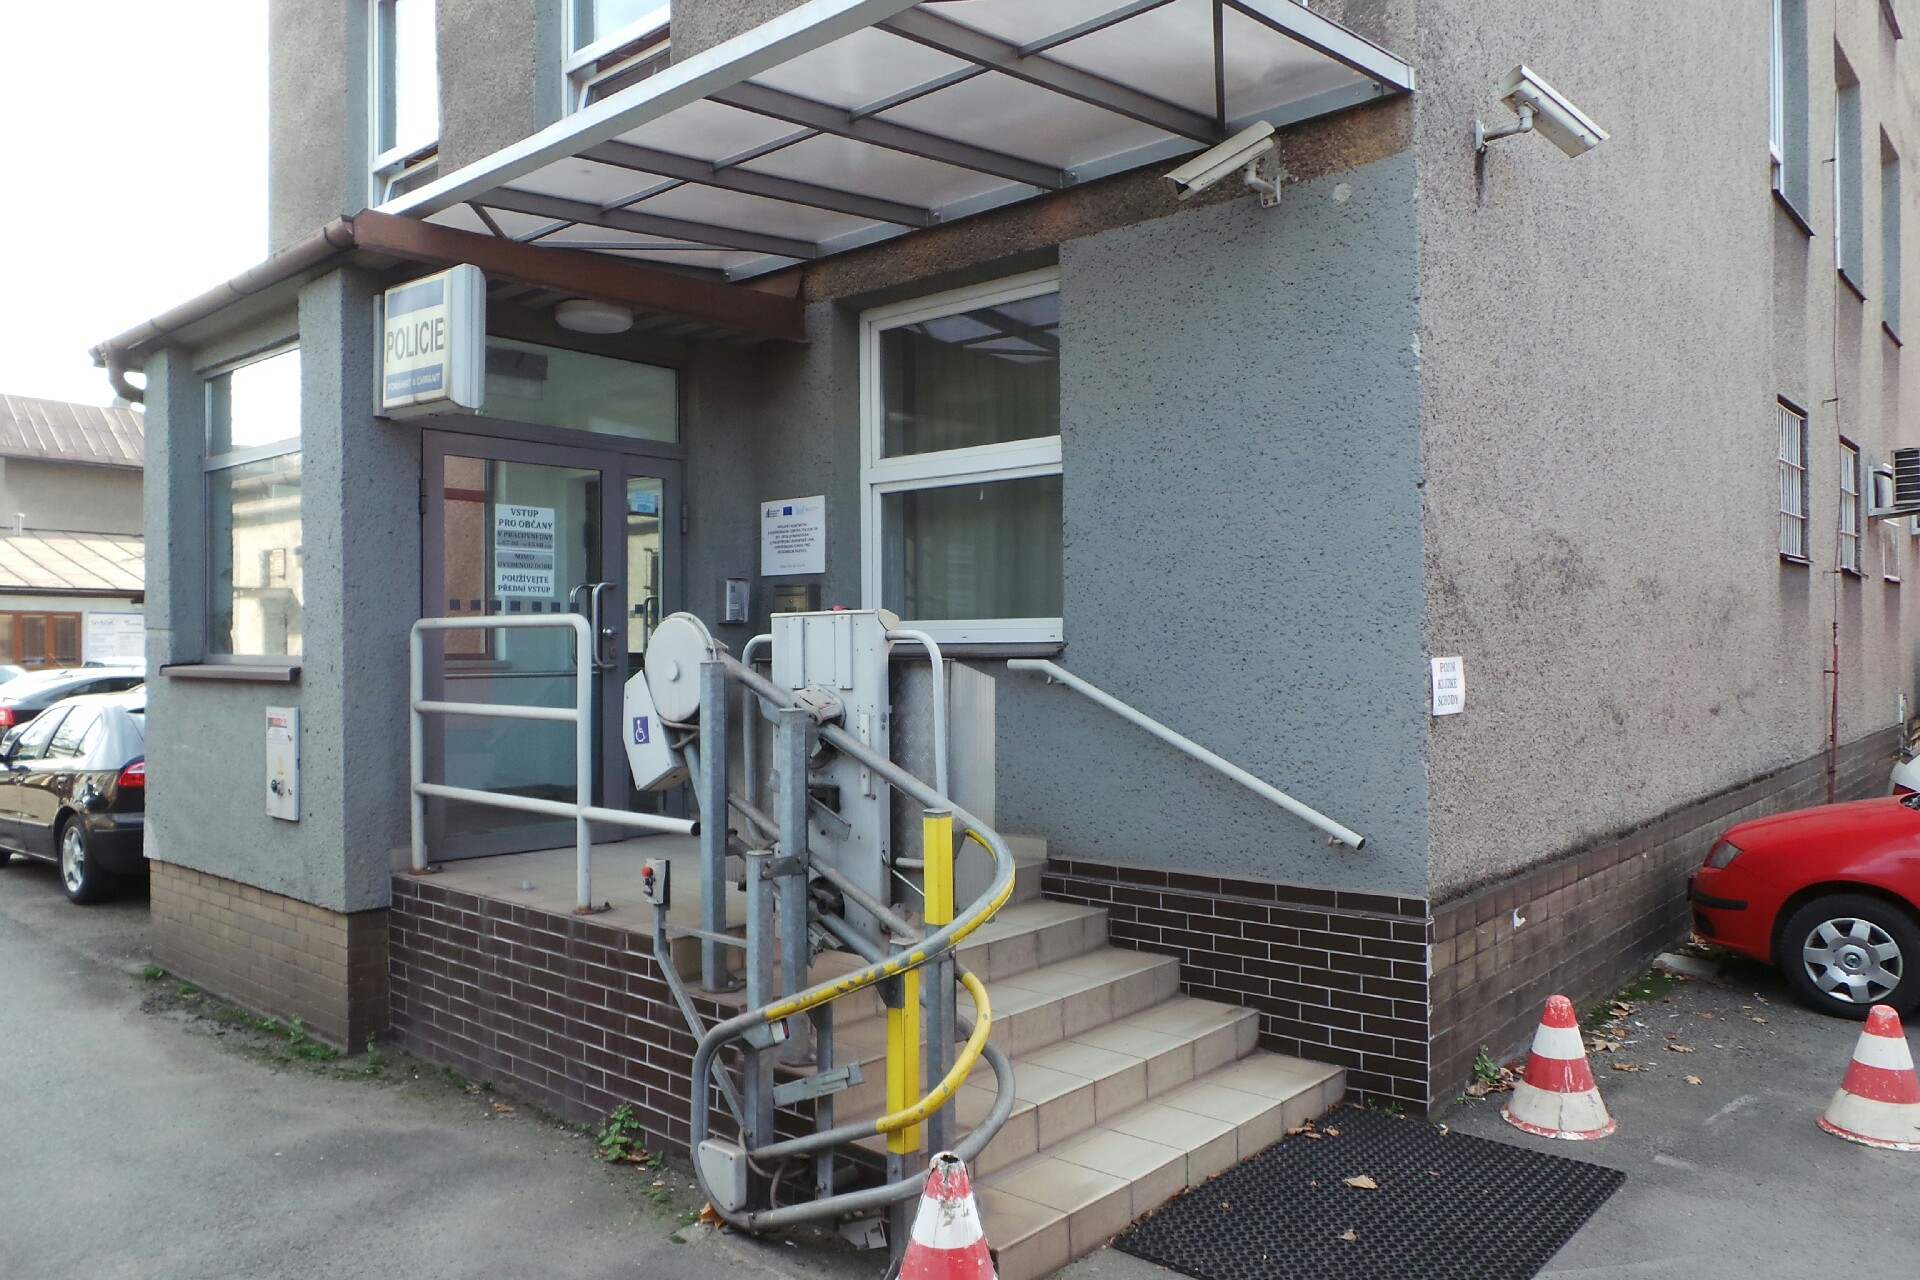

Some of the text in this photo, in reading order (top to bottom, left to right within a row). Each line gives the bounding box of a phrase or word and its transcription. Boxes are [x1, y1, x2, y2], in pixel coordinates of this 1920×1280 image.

[386, 318, 444, 363] POLICIE
[510, 508, 539, 517] VSTUP
[498, 519, 553, 530] PRO OBČANY
[501, 574, 549, 584] POUŽÍVEJTE
[498, 584, 551, 594] PŘEDNÍ VSTUP
